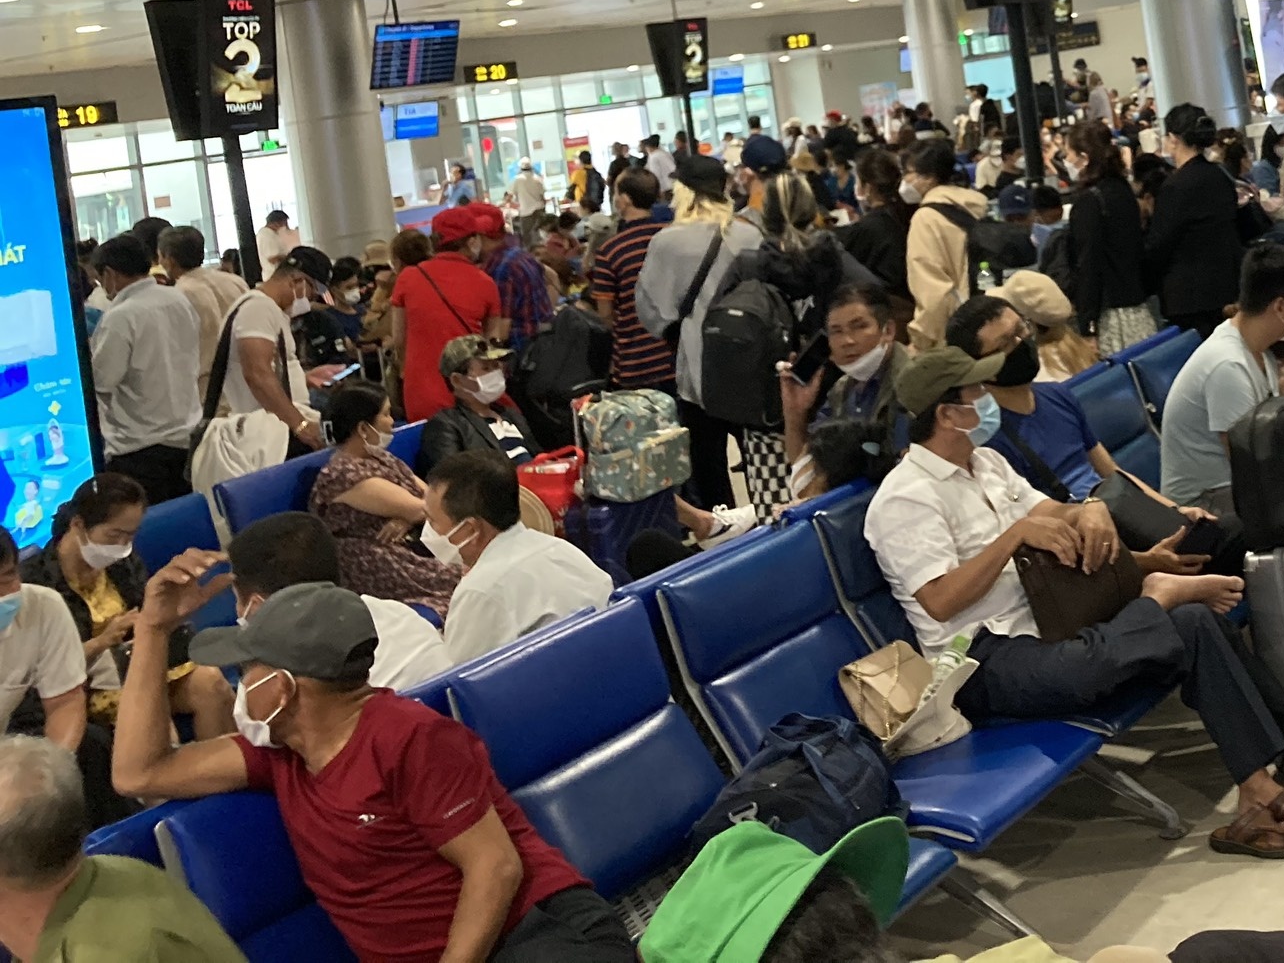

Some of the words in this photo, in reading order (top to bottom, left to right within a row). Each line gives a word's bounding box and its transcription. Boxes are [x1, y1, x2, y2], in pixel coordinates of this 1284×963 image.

[228, 0, 253, 11] TCL
[222, 21, 261, 40] TOP
[224, 37, 263, 103] 2
[685, 43, 703, 78] 2
[489, 64, 506, 80] 20
